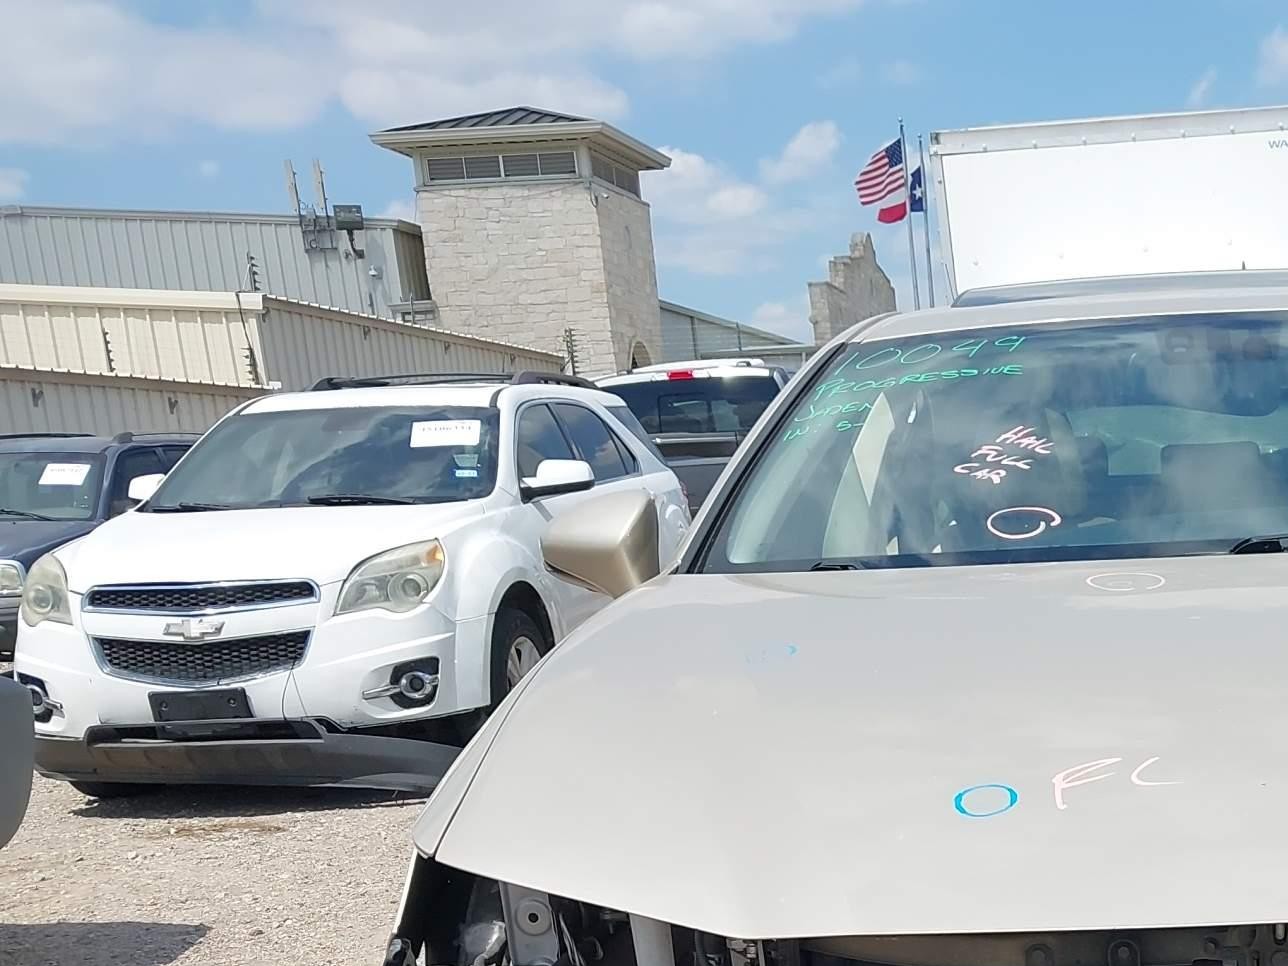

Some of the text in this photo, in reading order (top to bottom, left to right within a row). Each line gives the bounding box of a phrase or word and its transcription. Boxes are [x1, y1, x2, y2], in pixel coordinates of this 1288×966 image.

[814, 364, 1024, 401] PROGRESSIVE
[995, 425, 1055, 454] HAIL
[970, 445, 1034, 469] FULL
[953, 463, 1007, 484] CAR
